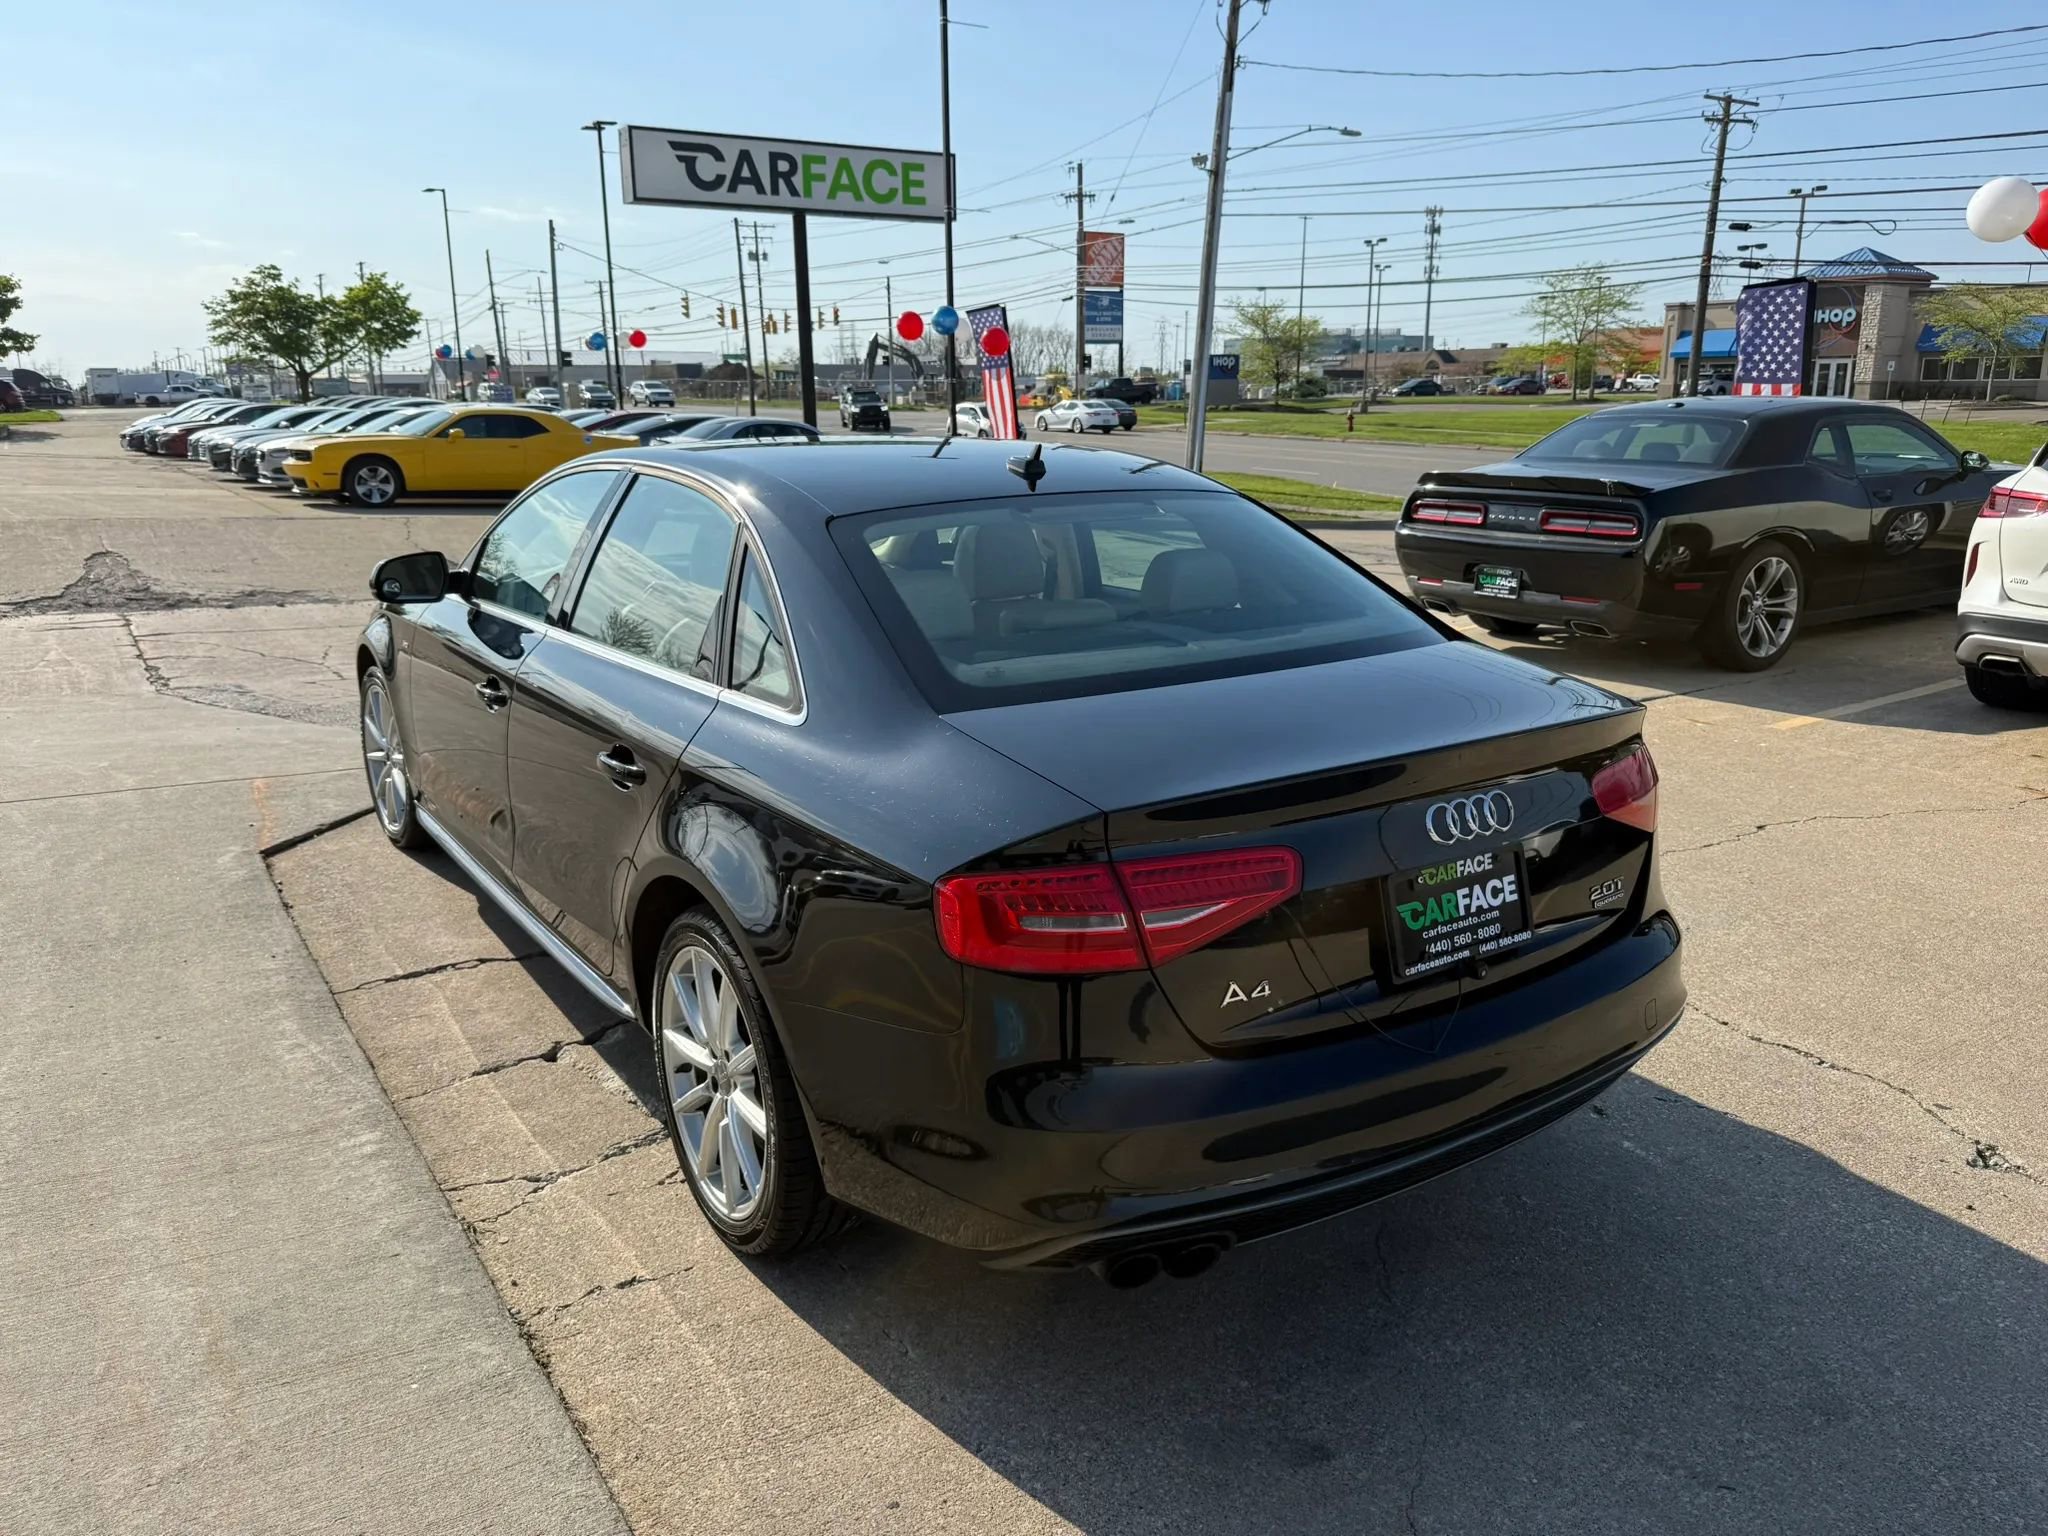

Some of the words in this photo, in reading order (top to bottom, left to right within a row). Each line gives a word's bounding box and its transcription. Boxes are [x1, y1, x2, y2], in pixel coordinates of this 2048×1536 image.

[666, 140, 927, 206] CARFACE
[1420, 852, 1493, 886] CARFACE
[1396, 874, 1519, 931] CARFACE
[1422, 910, 1500, 939] carfaceauto.com
[1404, 948, 1471, 977] carfaceauto.com
[1478, 938, 1498, 954] (440)
